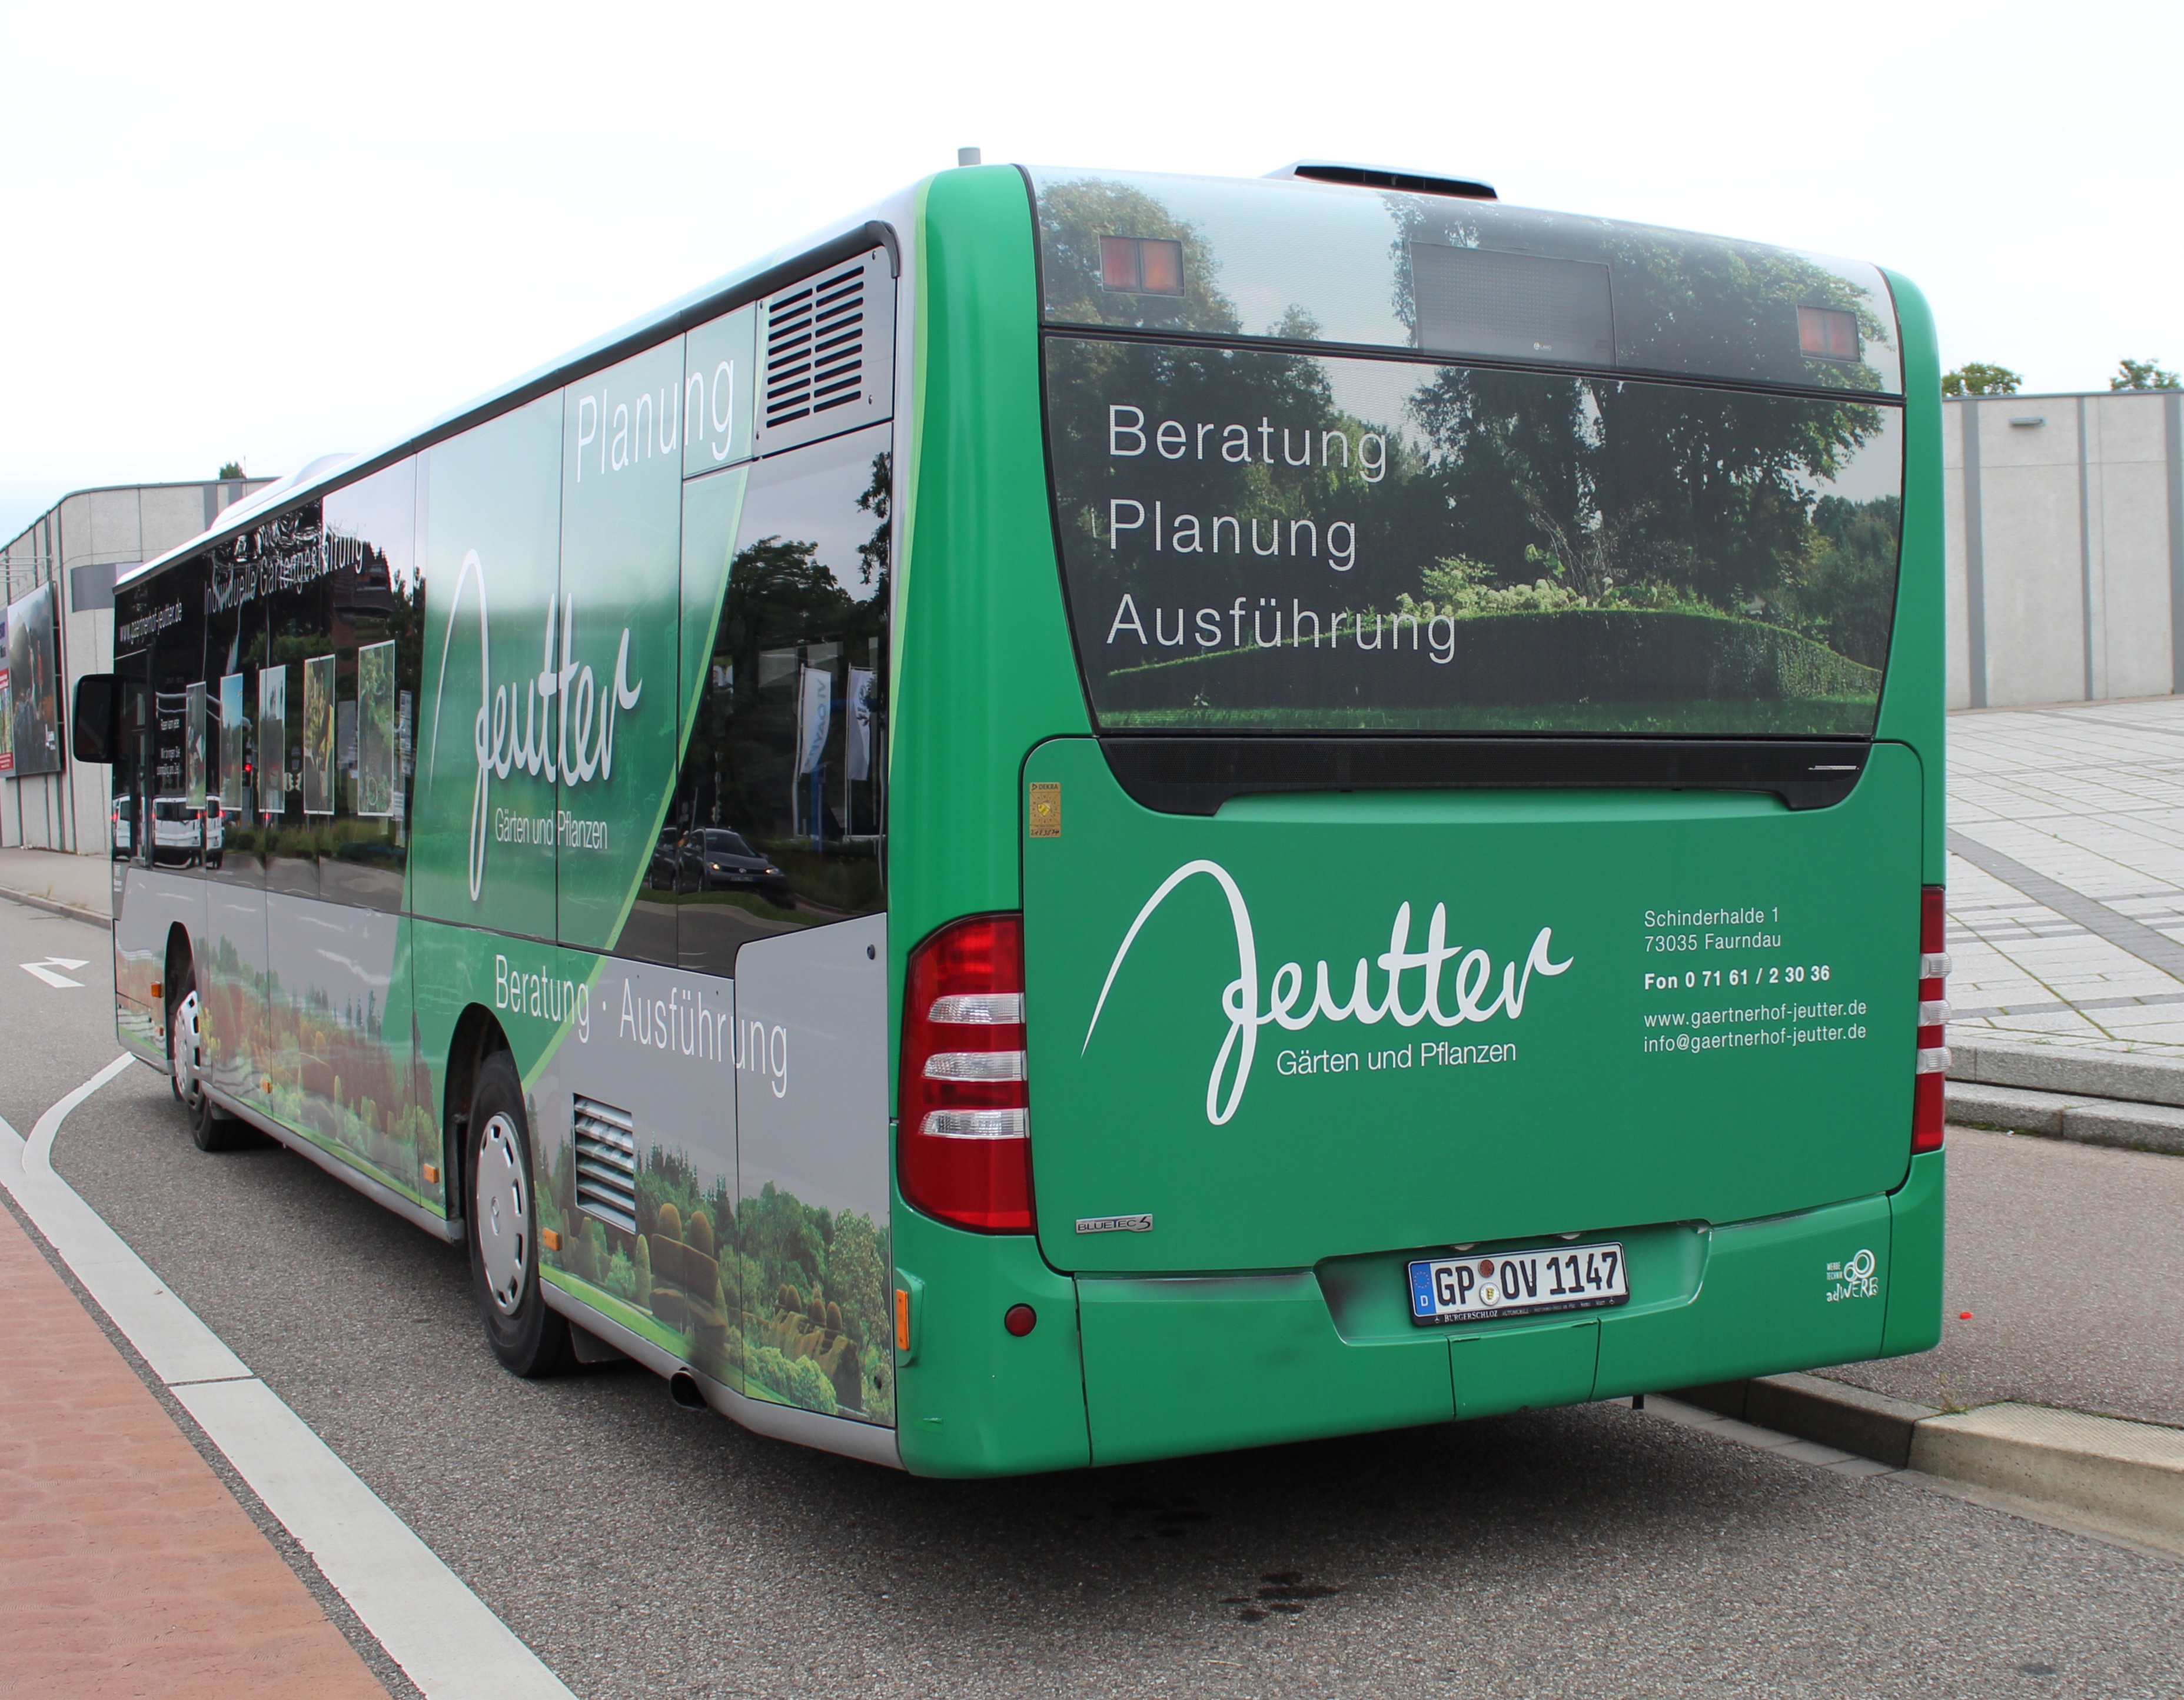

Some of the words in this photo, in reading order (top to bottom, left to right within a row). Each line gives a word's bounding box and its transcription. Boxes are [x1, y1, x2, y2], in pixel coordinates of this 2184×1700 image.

[577, 360, 734, 483] Planung
[1109, 404, 1387, 483] Beratung
[1110, 499, 1355, 571] Planung
[260, 531, 364, 596] Gartengestaltung
[1106, 593, 1455, 664] Ausführung
[430, 548, 643, 901] Jeutter
[496, 807, 529, 843] Gärten
[533, 810, 554, 846] und
[557, 810, 608, 850] Pflanzen
[1644, 907, 1764, 927] Schinderhalde
[1771, 907, 1779, 922] 1
[1645, 934, 1697, 952] 73035
[1706, 931, 1781, 950] Faurndau
[1081, 859, 1574, 1125] Jeutter
[1645, 973, 1678, 990] Fon
[1686, 972, 1696, 988] 0
[1702, 970, 1721, 987] 71
[1728, 969, 1748, 986] 61
[1755, 967, 1763, 984] /
[1769, 967, 1779, 984] 2
[1785, 966, 1804, 983] 30
[1811, 965, 1830, 982] 36
[496, 954, 589, 1043] Beratung
[620, 978, 787, 1099] Ausführung
[1644, 999, 1867, 1029] www.gaertnerhof-jeutter.de
[1644, 1023, 1867, 1054] info@gaertnerhof-jeutter.de
[1277, 1050, 1359, 1076] Gärten
[1368, 1043, 1412, 1070] und
[1421, 1040, 1517, 1067] Pflanzen
[1420, 1295, 1429, 1307] D
[1435, 1265, 1475, 1306] GP
[1500, 1259, 1537, 1300] OV
[1546, 1251, 1618, 1295] 1147
[1826, 1262, 1841, 1271] WERBE
[1826, 1271, 1843, 1280] TECHNIK
